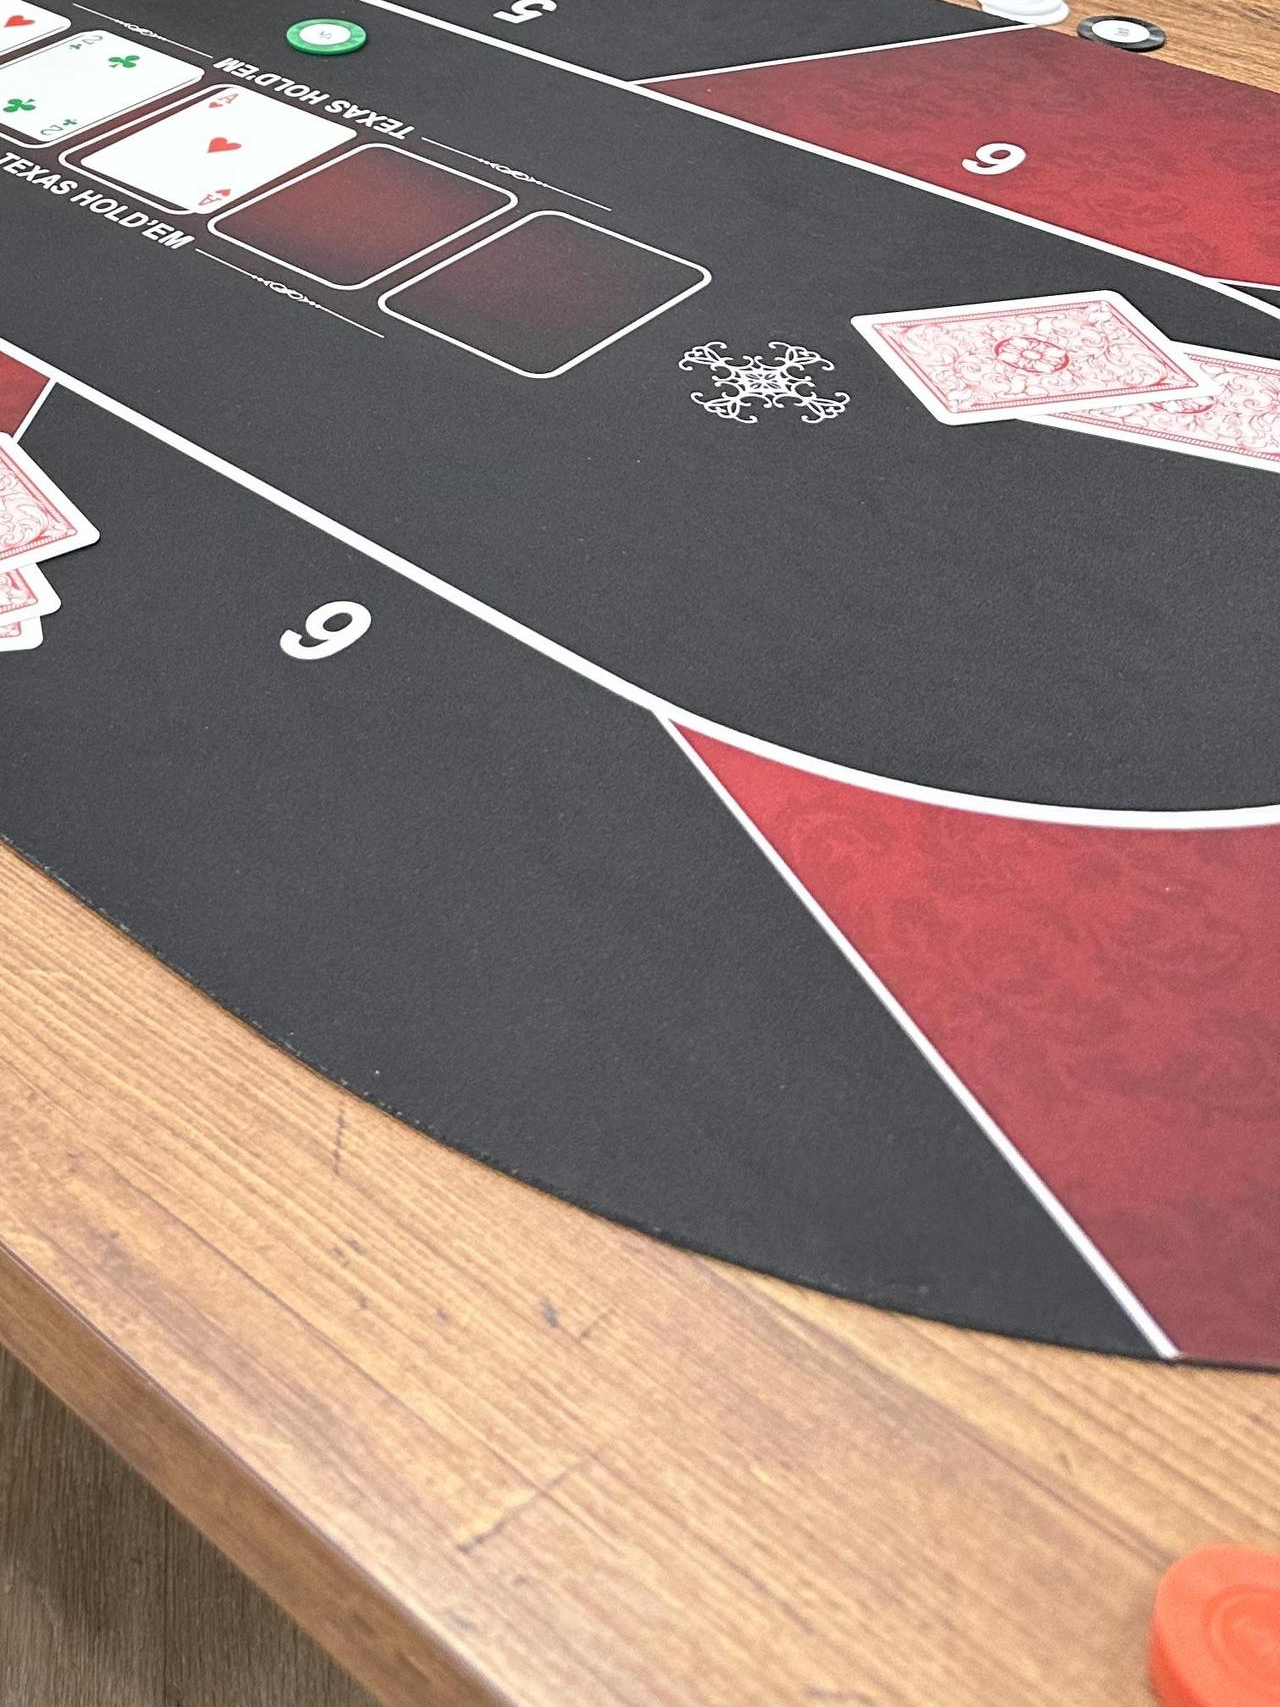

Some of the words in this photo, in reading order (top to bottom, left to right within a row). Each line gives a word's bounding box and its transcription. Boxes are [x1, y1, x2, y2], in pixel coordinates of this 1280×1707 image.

[82, 34, 104, 45] 2
[212, 57, 330, 105] HOLD'EM
[219, 93, 240, 104] A
[39, 124, 65, 136] 2
[324, 99, 415, 140] TEXAS
[197, 193, 223, 206] A
[70, 189, 196, 250] HOLD'EM
[280, 600, 372, 660] 9
